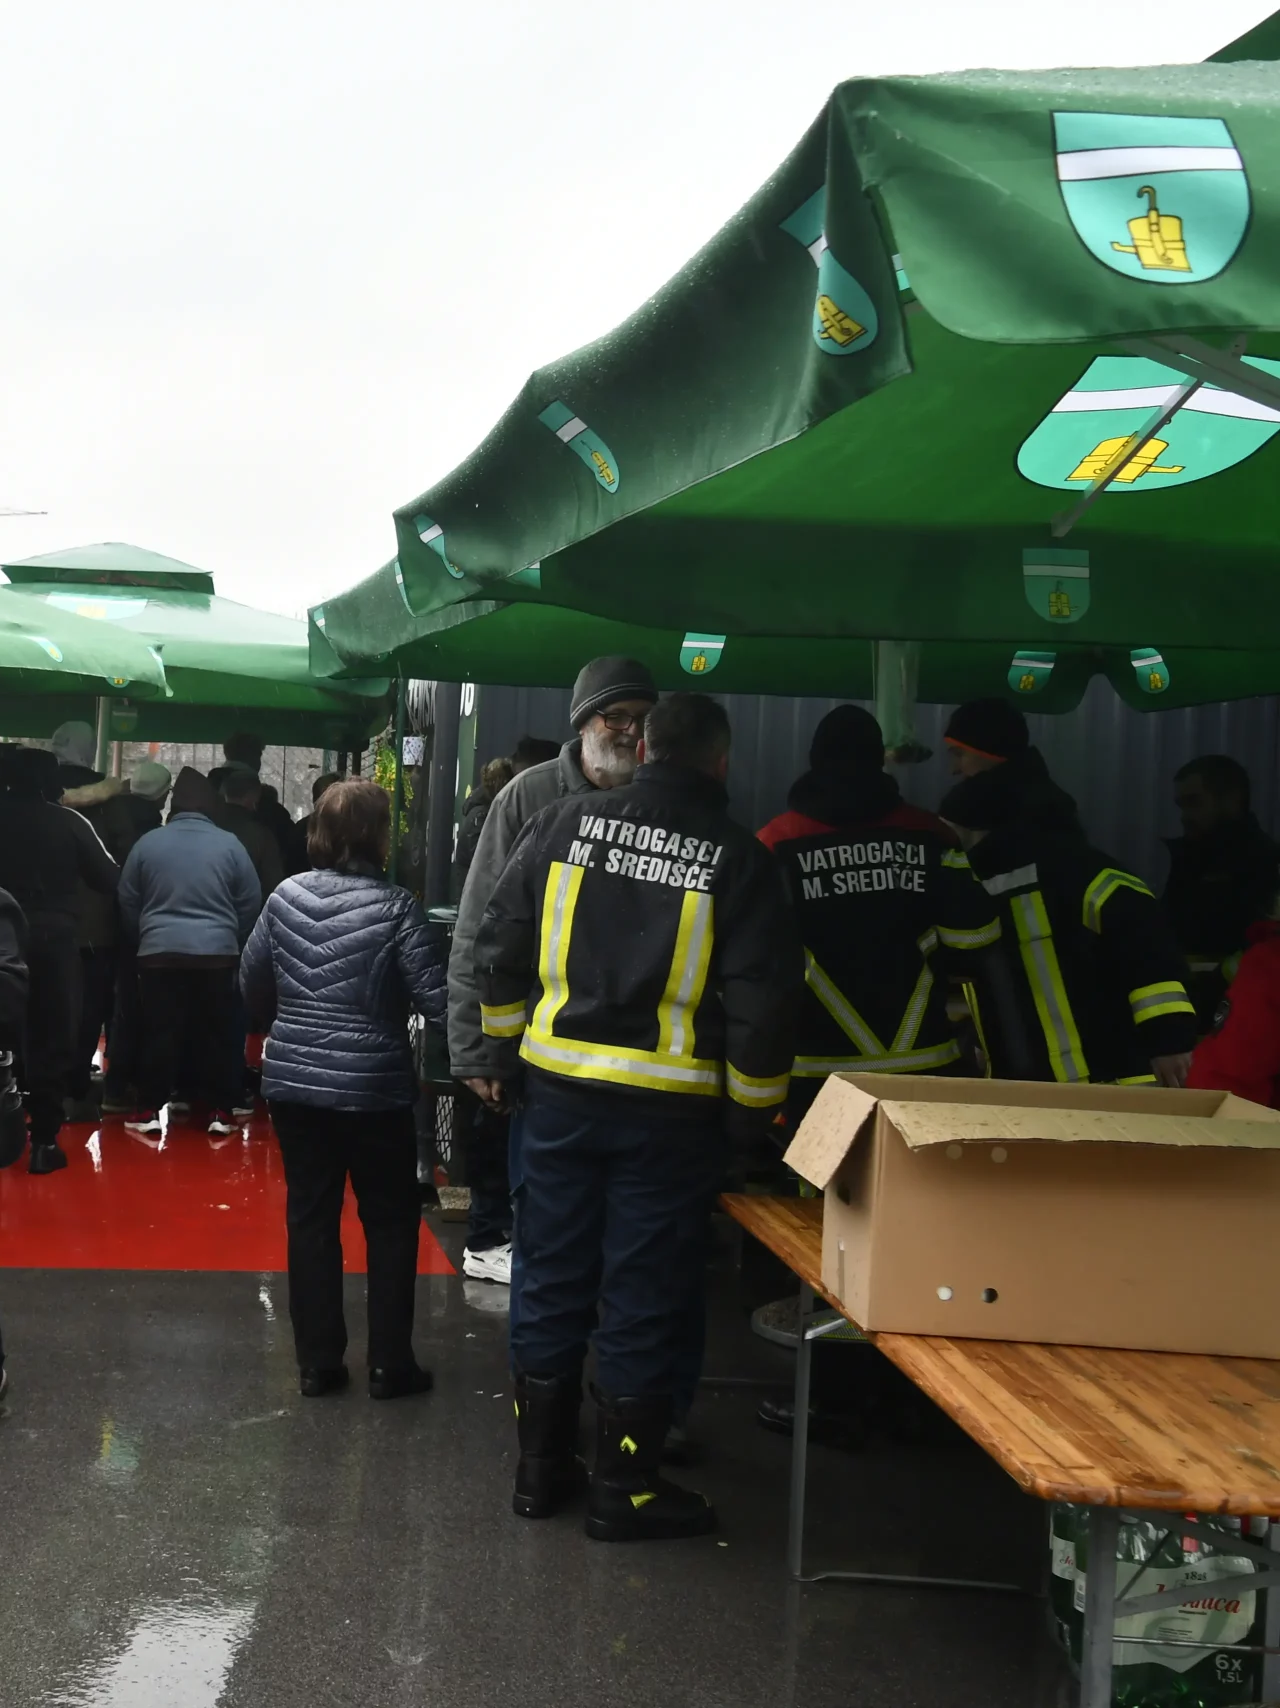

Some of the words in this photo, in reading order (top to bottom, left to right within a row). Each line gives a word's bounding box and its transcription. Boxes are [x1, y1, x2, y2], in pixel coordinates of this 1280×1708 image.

[578, 815, 723, 865] VATROGASCI
[797, 840, 926, 873] VATROGASCI
[567, 840, 595, 868] M.
[605, 848, 714, 890] SREDIŠĆE
[802, 876, 830, 900] M.
